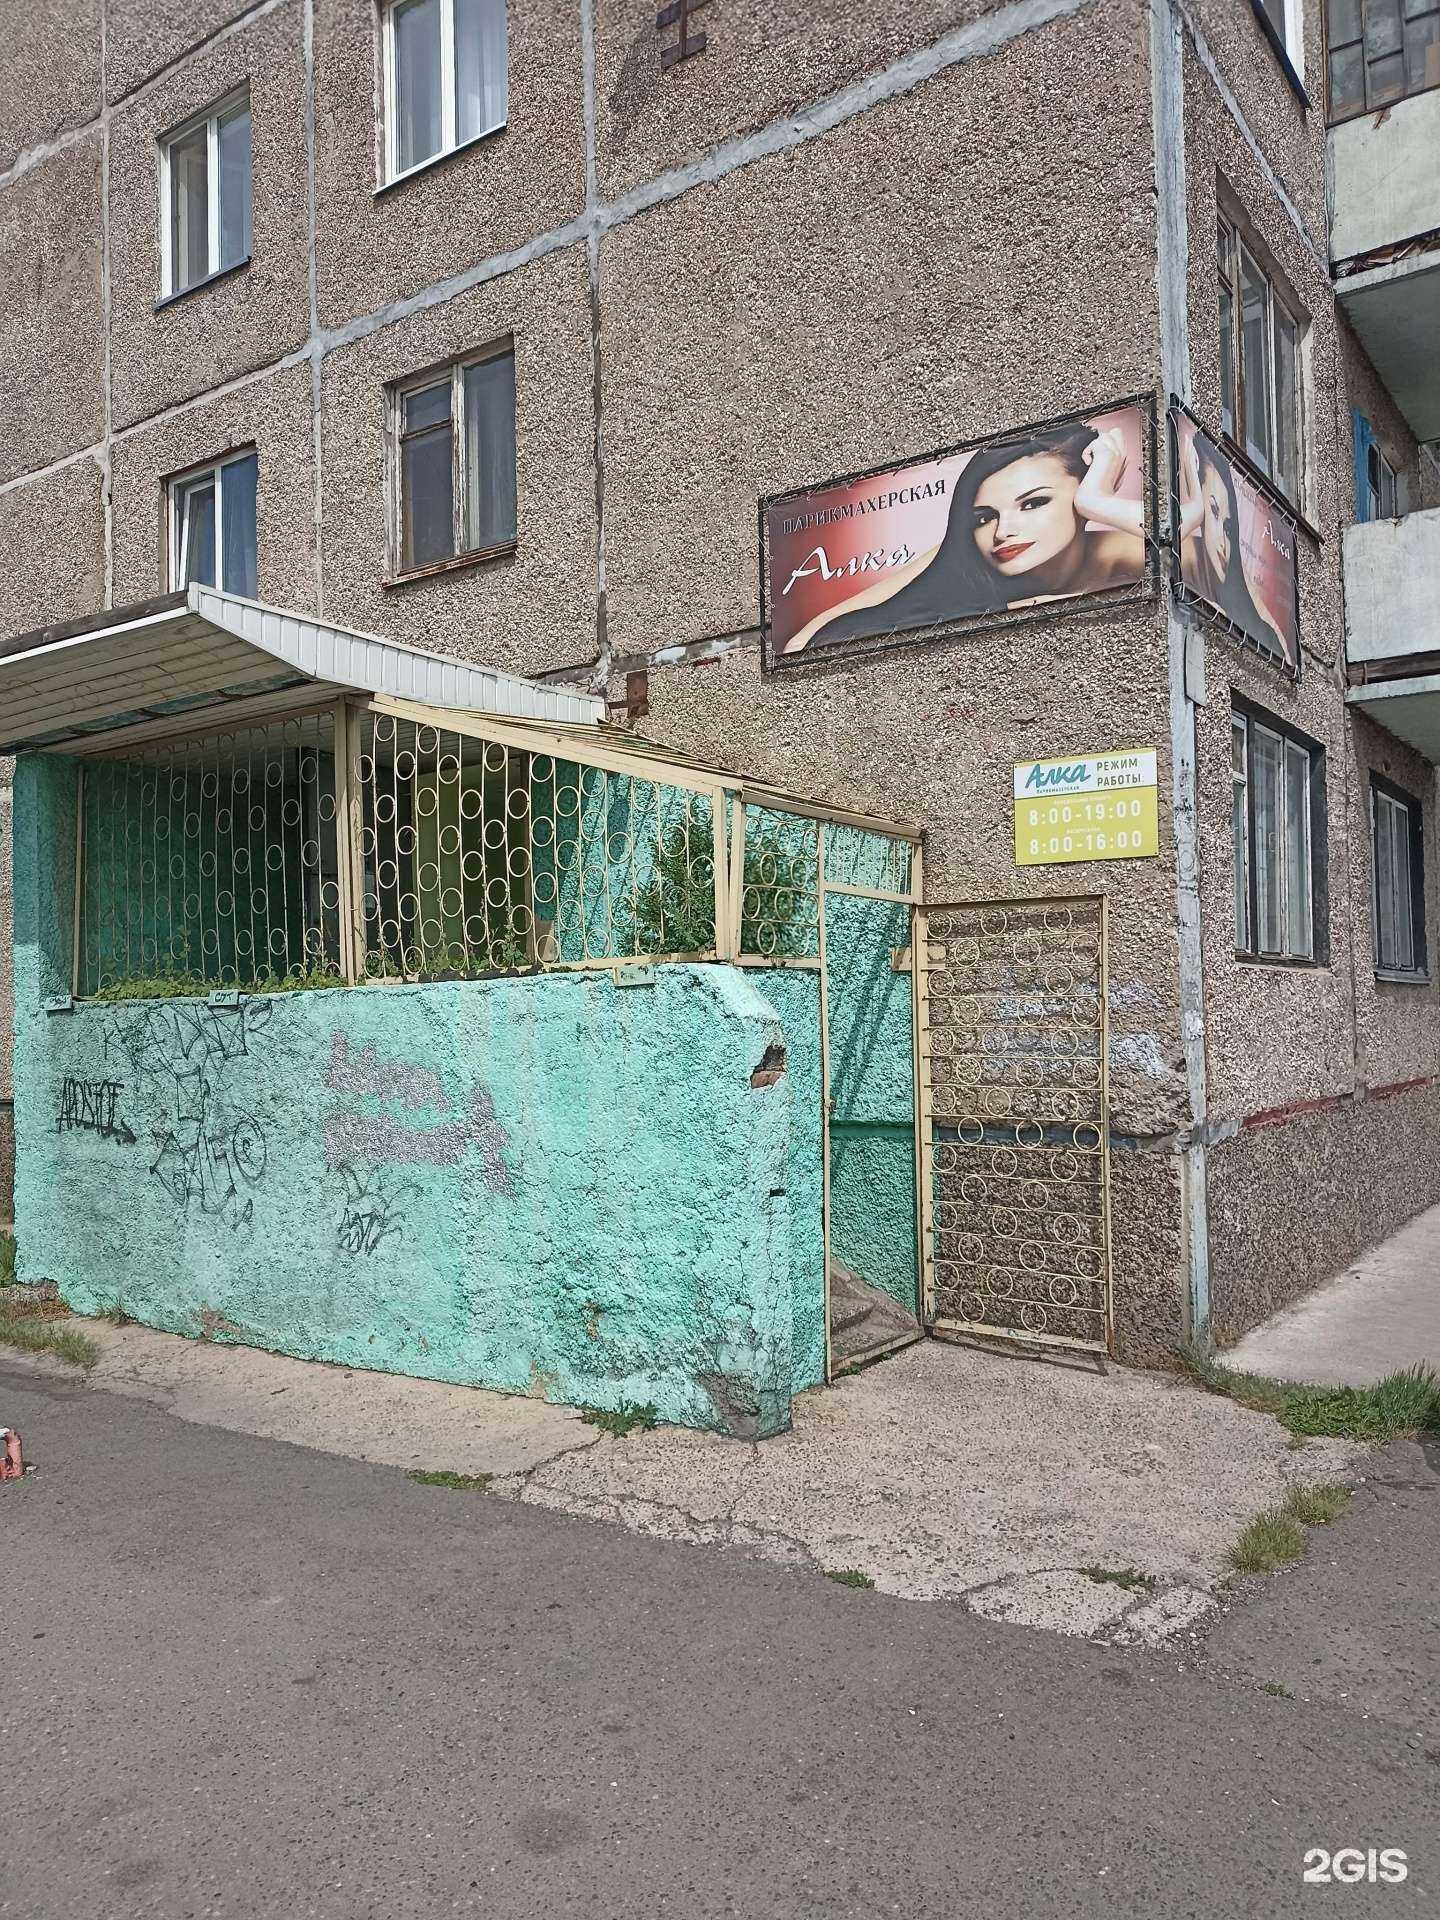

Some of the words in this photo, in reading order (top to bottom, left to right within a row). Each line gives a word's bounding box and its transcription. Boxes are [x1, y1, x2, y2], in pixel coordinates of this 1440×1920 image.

[782, 479, 946, 535] ПАРИКМАХЕРСКАЯ
[782, 544, 916, 596] Алка
[1025, 763, 1091, 788] Алка
[1096, 758, 1138, 772] РЕЖИМ
